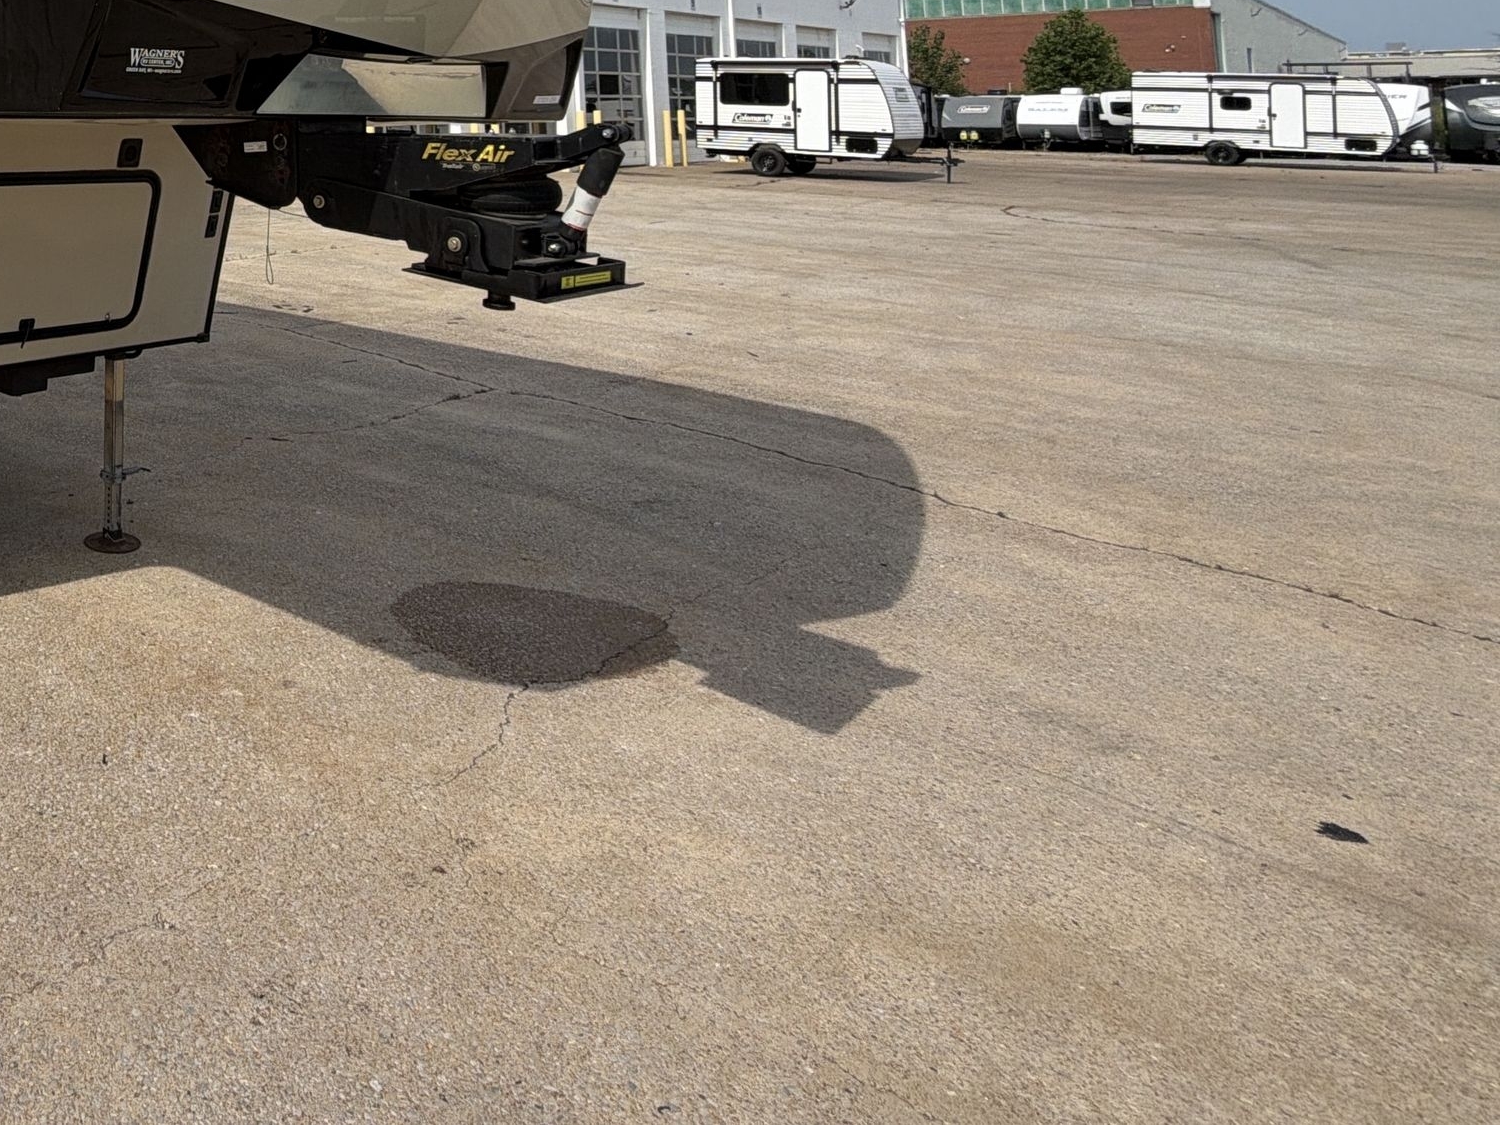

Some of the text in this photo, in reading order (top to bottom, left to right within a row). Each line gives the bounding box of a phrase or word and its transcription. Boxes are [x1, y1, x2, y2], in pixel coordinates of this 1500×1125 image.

[130, 47, 185, 68] WAGNER'S
[735, 113, 765, 122] Coleman
[421, 142, 515, 163] Flex Air
